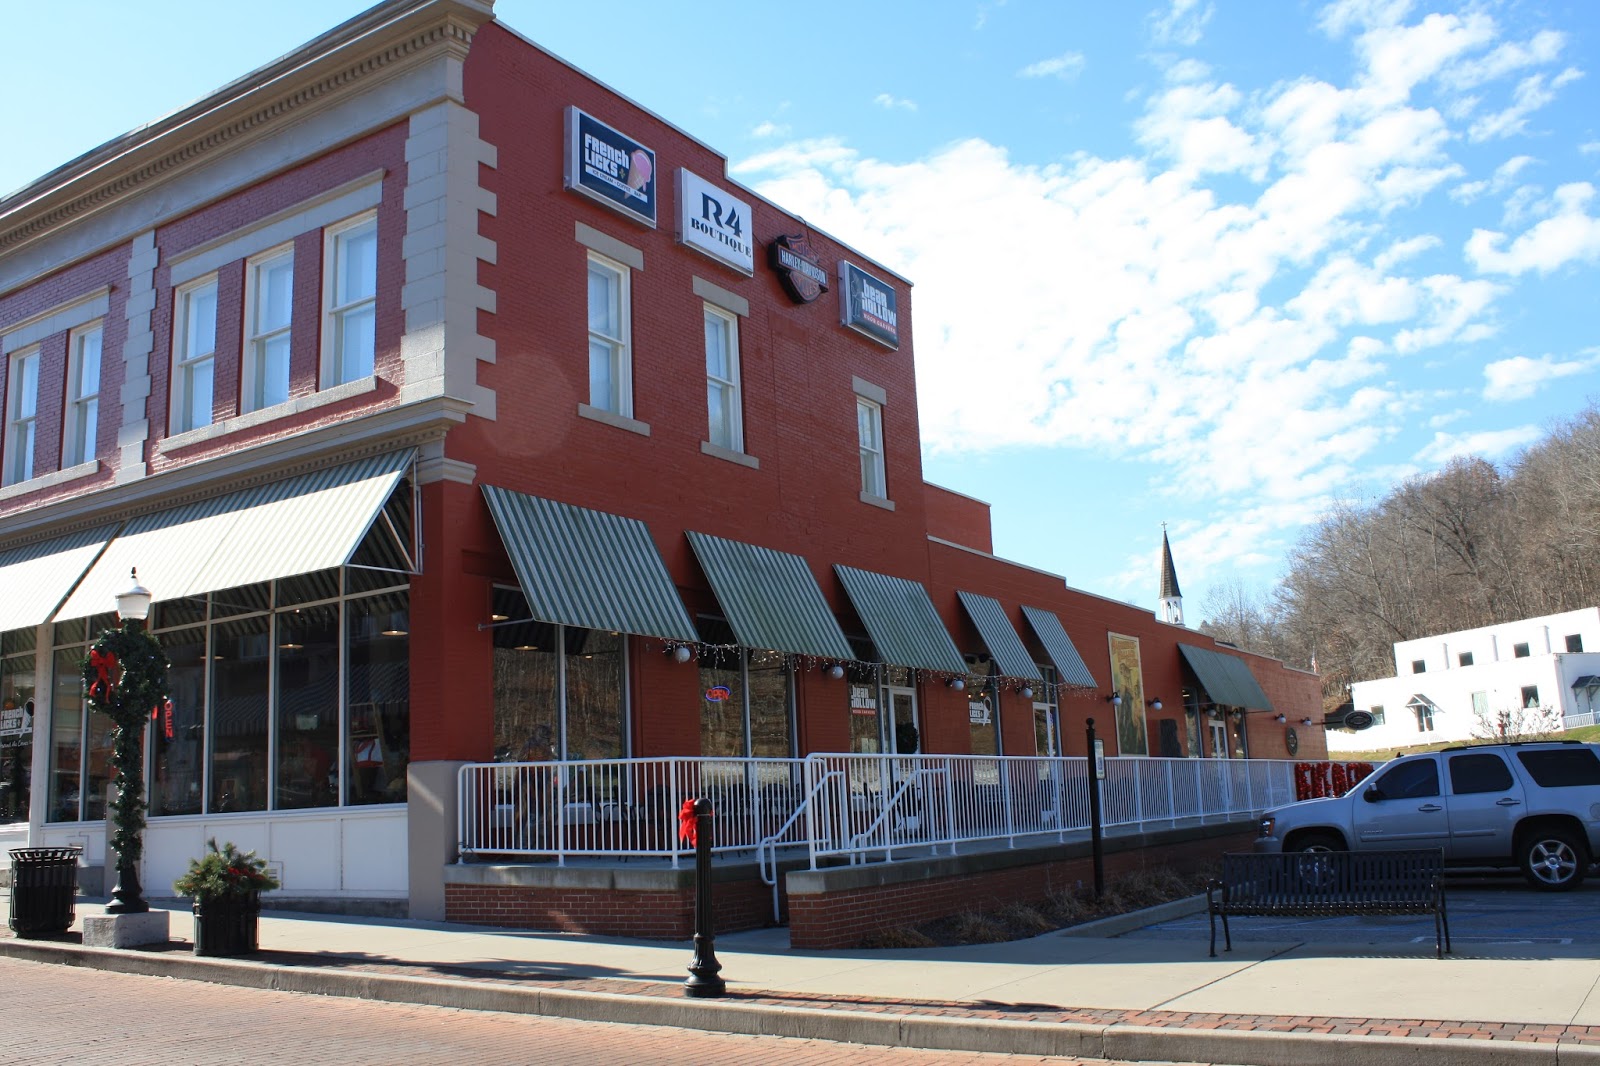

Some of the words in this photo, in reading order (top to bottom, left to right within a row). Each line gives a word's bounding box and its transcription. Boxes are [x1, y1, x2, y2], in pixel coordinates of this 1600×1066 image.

[585, 147, 618, 178] LICKS
[701, 192, 742, 238] R4
[691, 217, 751, 258] BOUTIQUE
[706, 688, 729, 700] OPEN
[164, 702, 174, 737] OPEN
